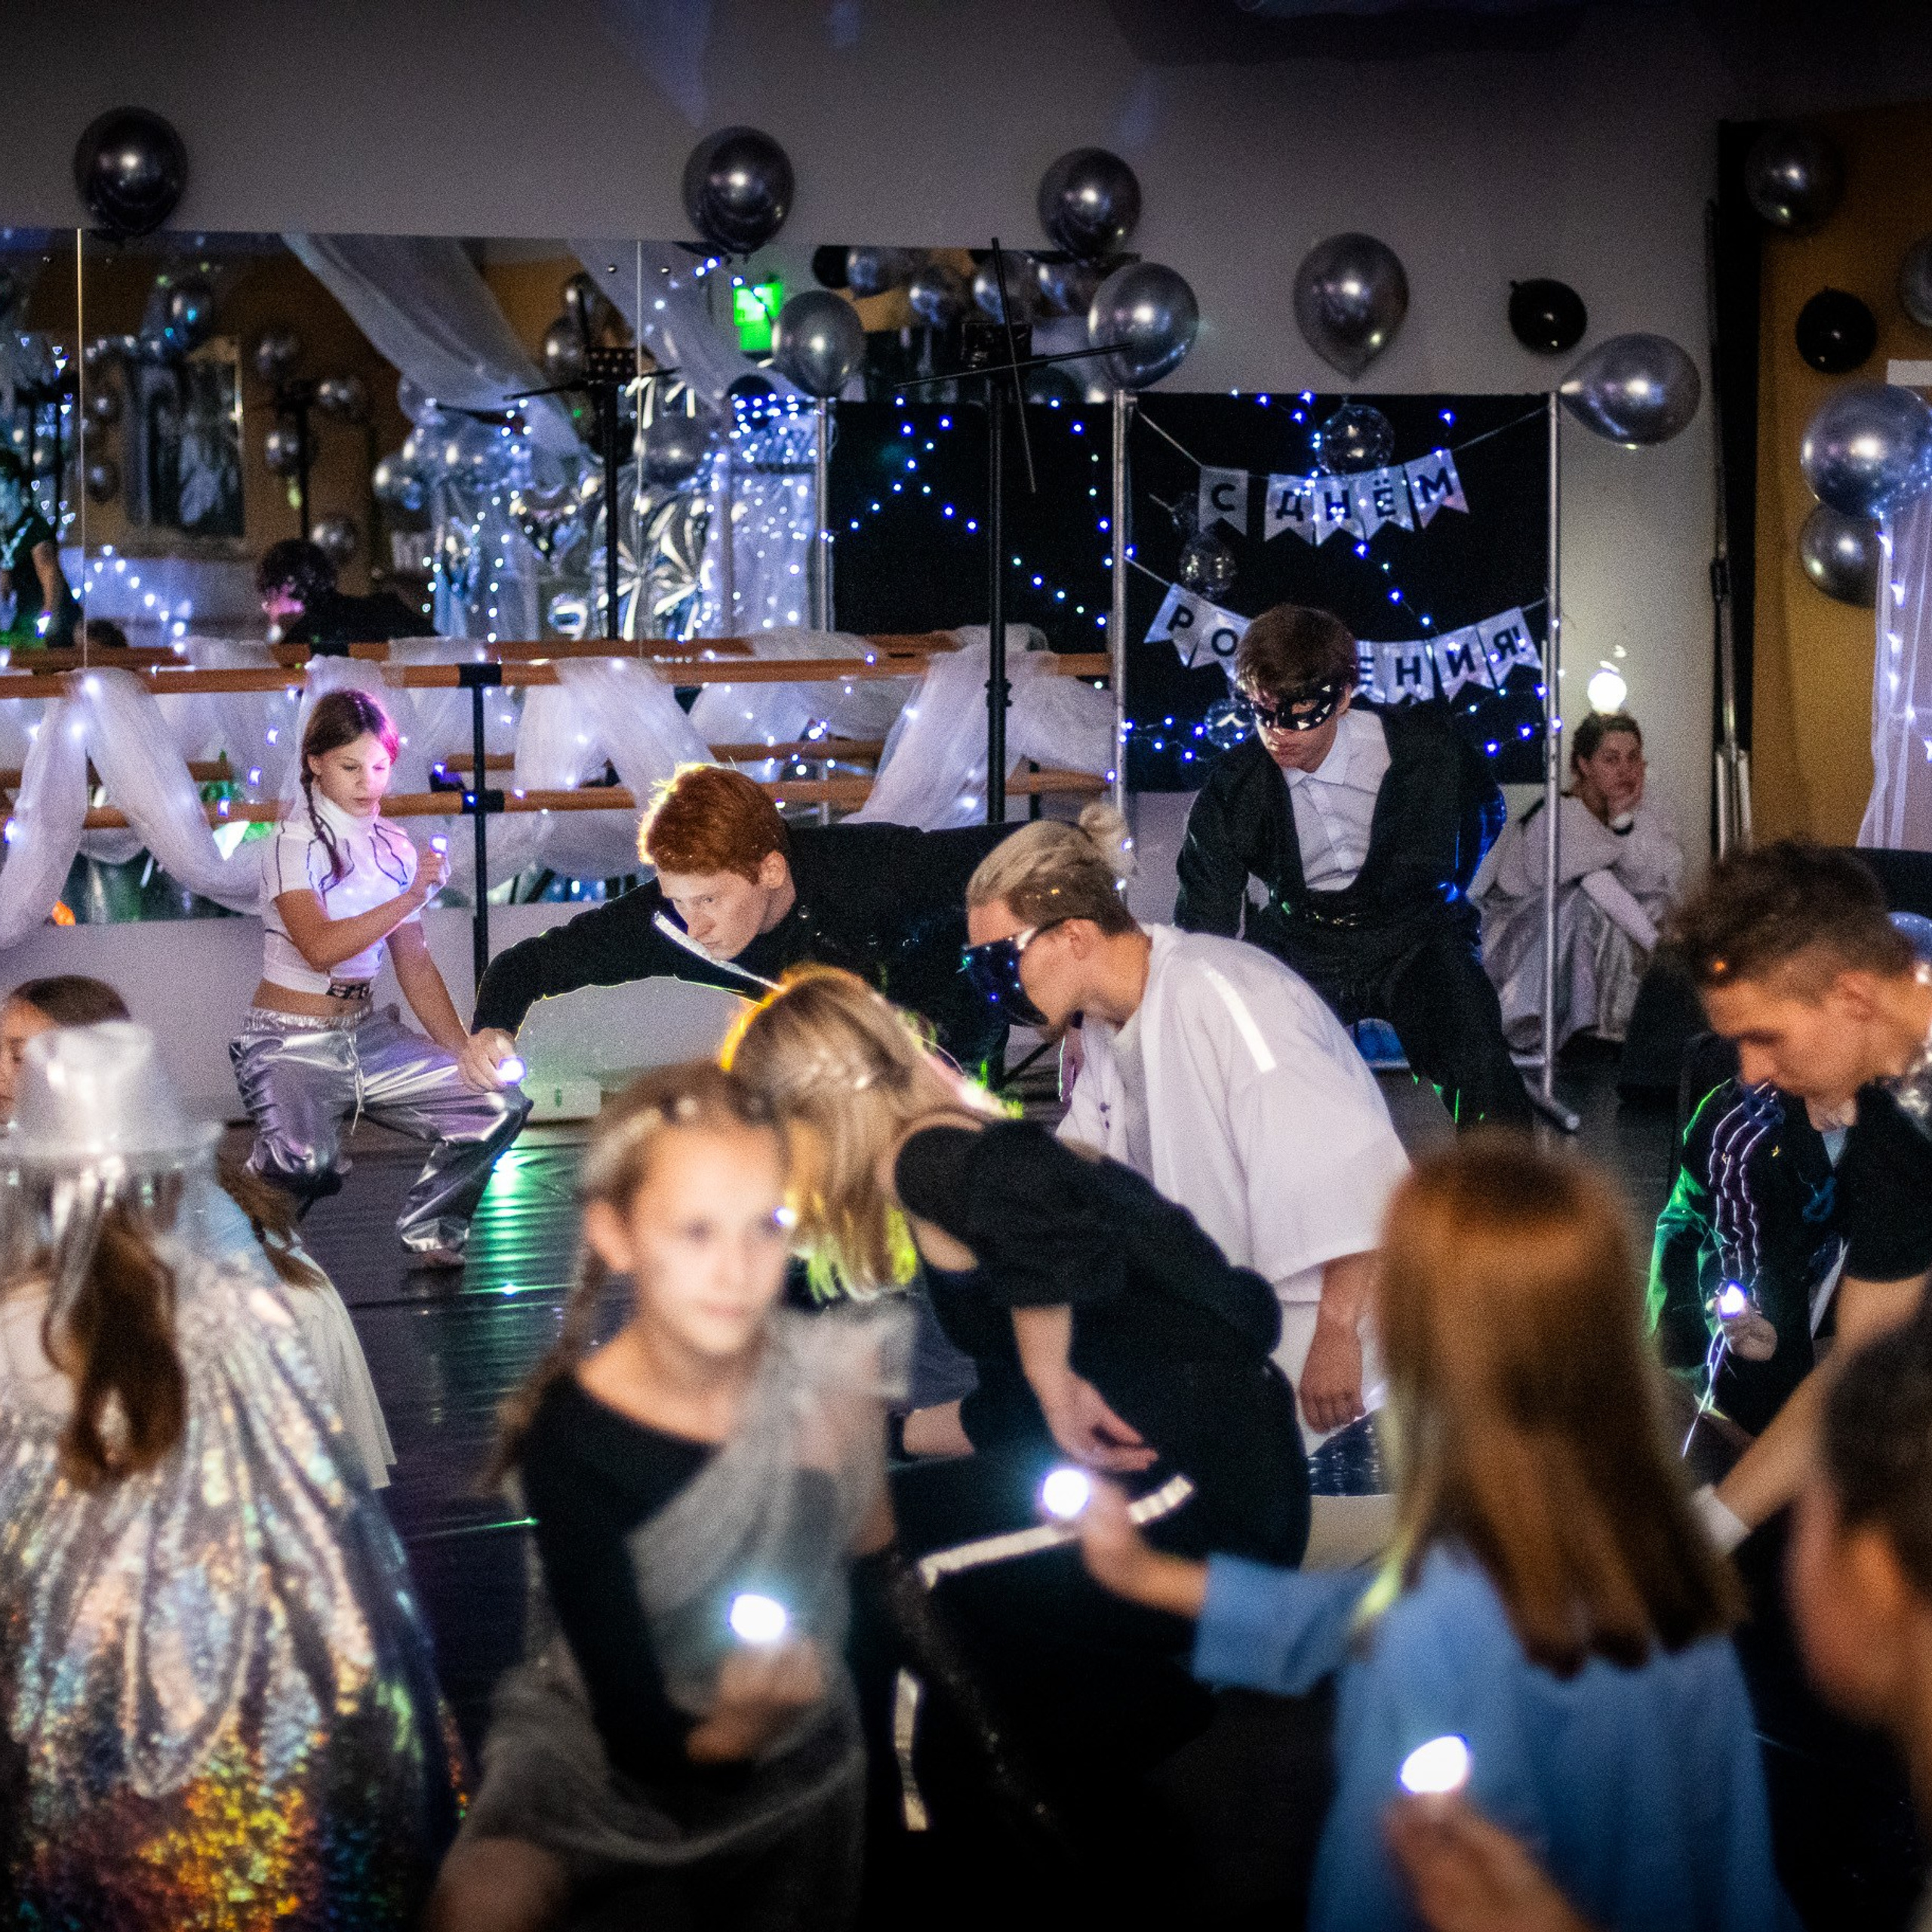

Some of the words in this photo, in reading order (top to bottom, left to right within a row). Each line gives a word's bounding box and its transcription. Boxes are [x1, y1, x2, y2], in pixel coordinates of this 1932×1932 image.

[1211, 482, 1236, 512] С
[1275, 466, 1455, 522] ДНЁМ
[1165, 603, 1527, 687] РОЕНИЯ!
